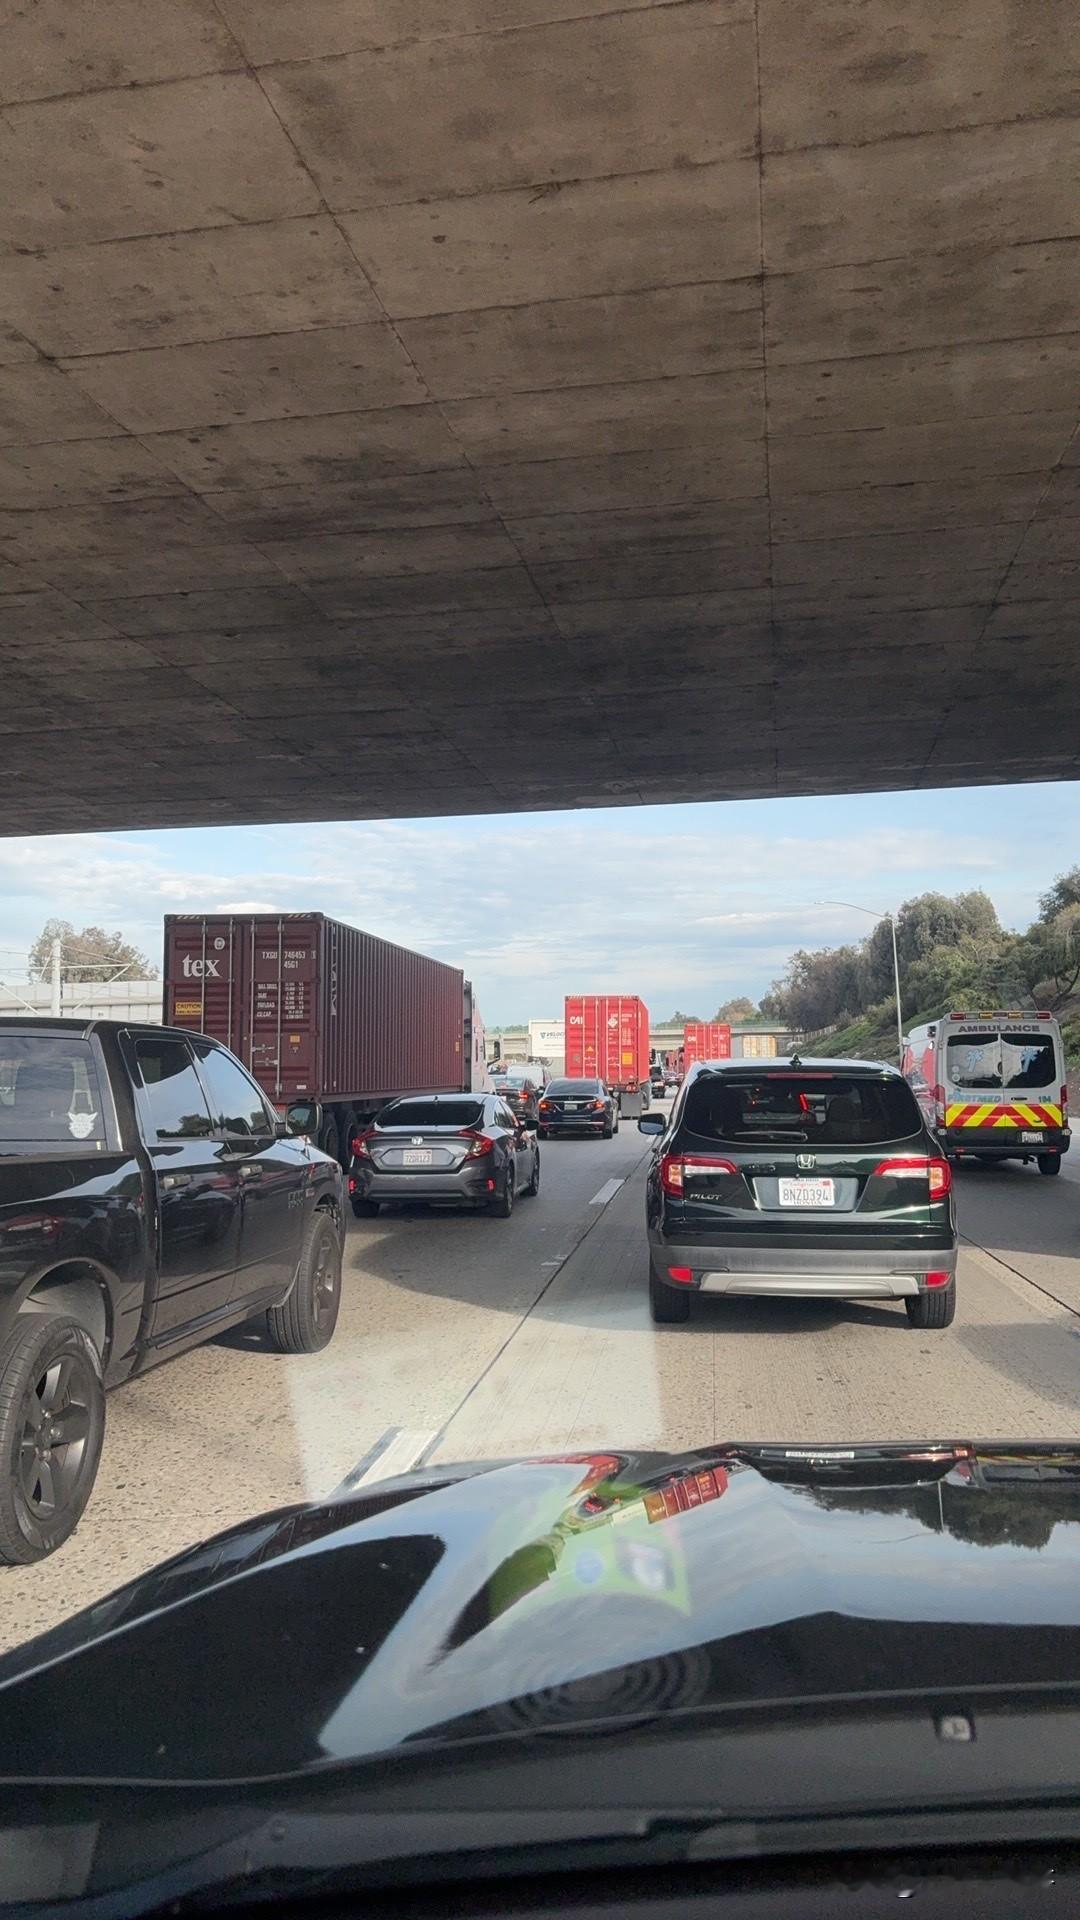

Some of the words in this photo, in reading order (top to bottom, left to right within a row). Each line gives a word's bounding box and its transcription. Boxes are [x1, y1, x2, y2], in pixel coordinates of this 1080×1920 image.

[262, 951, 278, 959] TXGU
[182, 954, 220, 978] tex
[569, 1016, 583, 1025] CAI
[958, 1024, 1040, 1032] AMBULANCE
[689, 1193, 722, 1201] PILOT
[783, 1188, 829, 1201] 8NZD394
